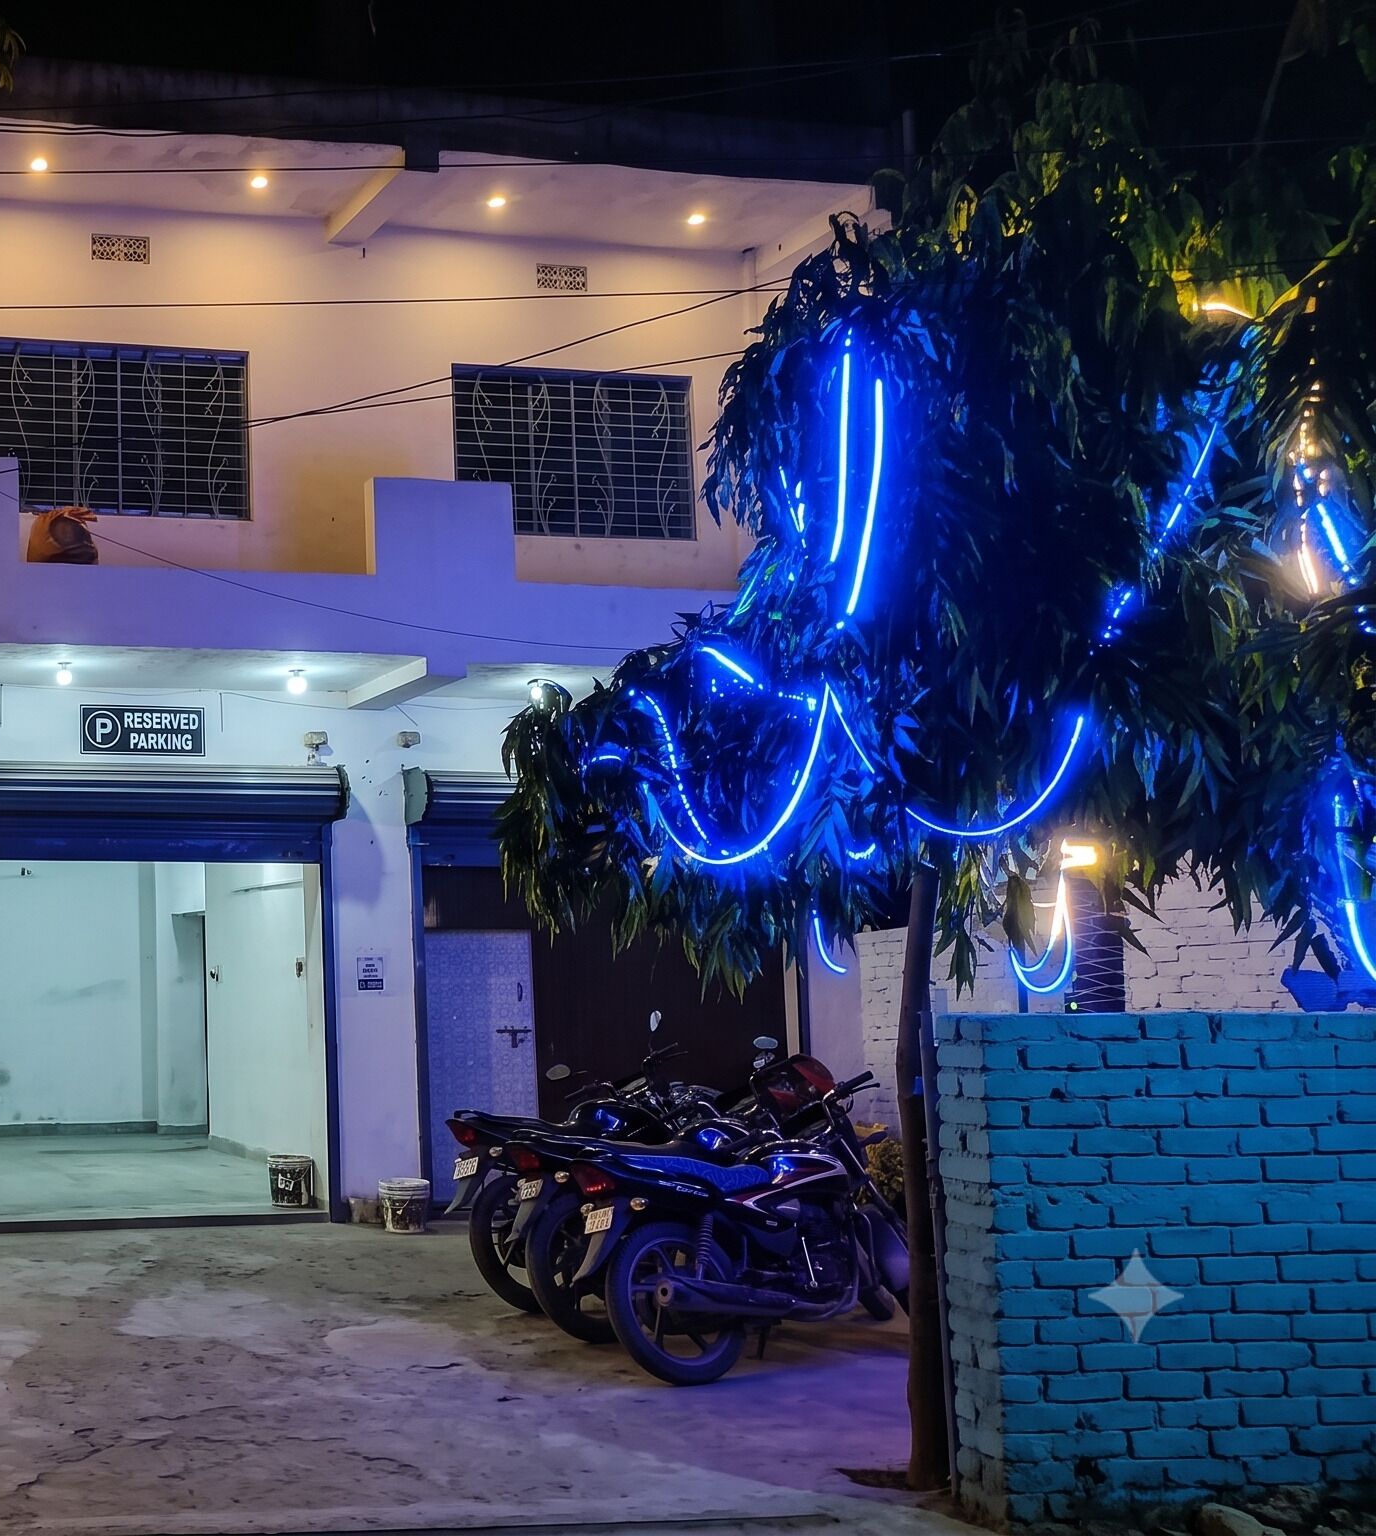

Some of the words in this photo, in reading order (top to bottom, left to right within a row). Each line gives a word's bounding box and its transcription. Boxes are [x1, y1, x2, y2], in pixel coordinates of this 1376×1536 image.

[124, 712, 199, 730] RESERVED
[95, 718, 113, 743] P
[130, 732, 193, 750] PARKING
